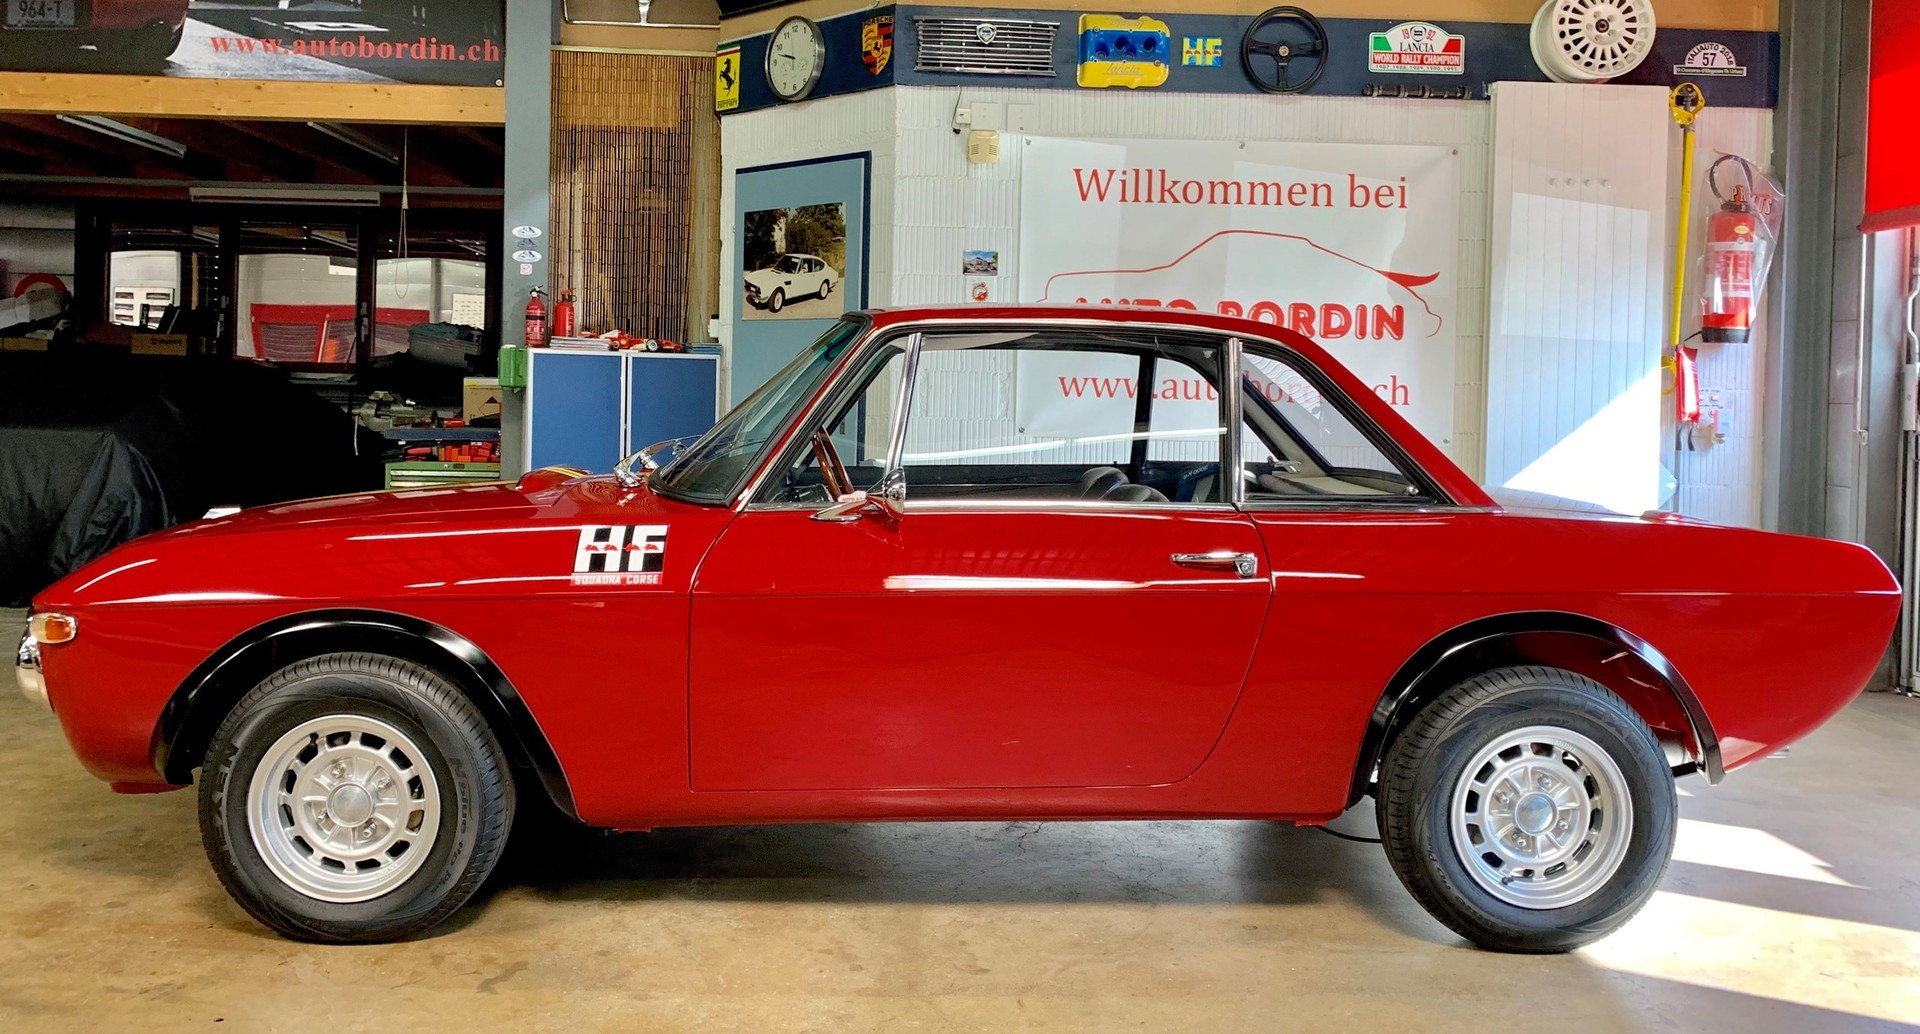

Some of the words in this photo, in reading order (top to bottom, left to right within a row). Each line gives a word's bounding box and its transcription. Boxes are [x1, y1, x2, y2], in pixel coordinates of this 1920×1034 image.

[1401, 28, 1410, 40] 19
[1425, 29, 1437, 41] 92
[210, 35, 500, 62] www.autobordin.ch
[1182, 38, 1222, 65] HF
[1400, 42, 1433, 52] LANCIA
[1373, 53, 1400, 63] WORLD
[1400, 55, 1422, 65] RALLY
[1423, 56, 1460, 66] CHAMPION
[1702, 52, 1717, 66] 57
[1072, 168, 1334, 207] Willkommen
[1347, 173, 1408, 209] bei
[574, 525, 667, 572] HF
[574, 574, 622, 585] SQUADRA
[626, 574, 659, 585] CORSE
